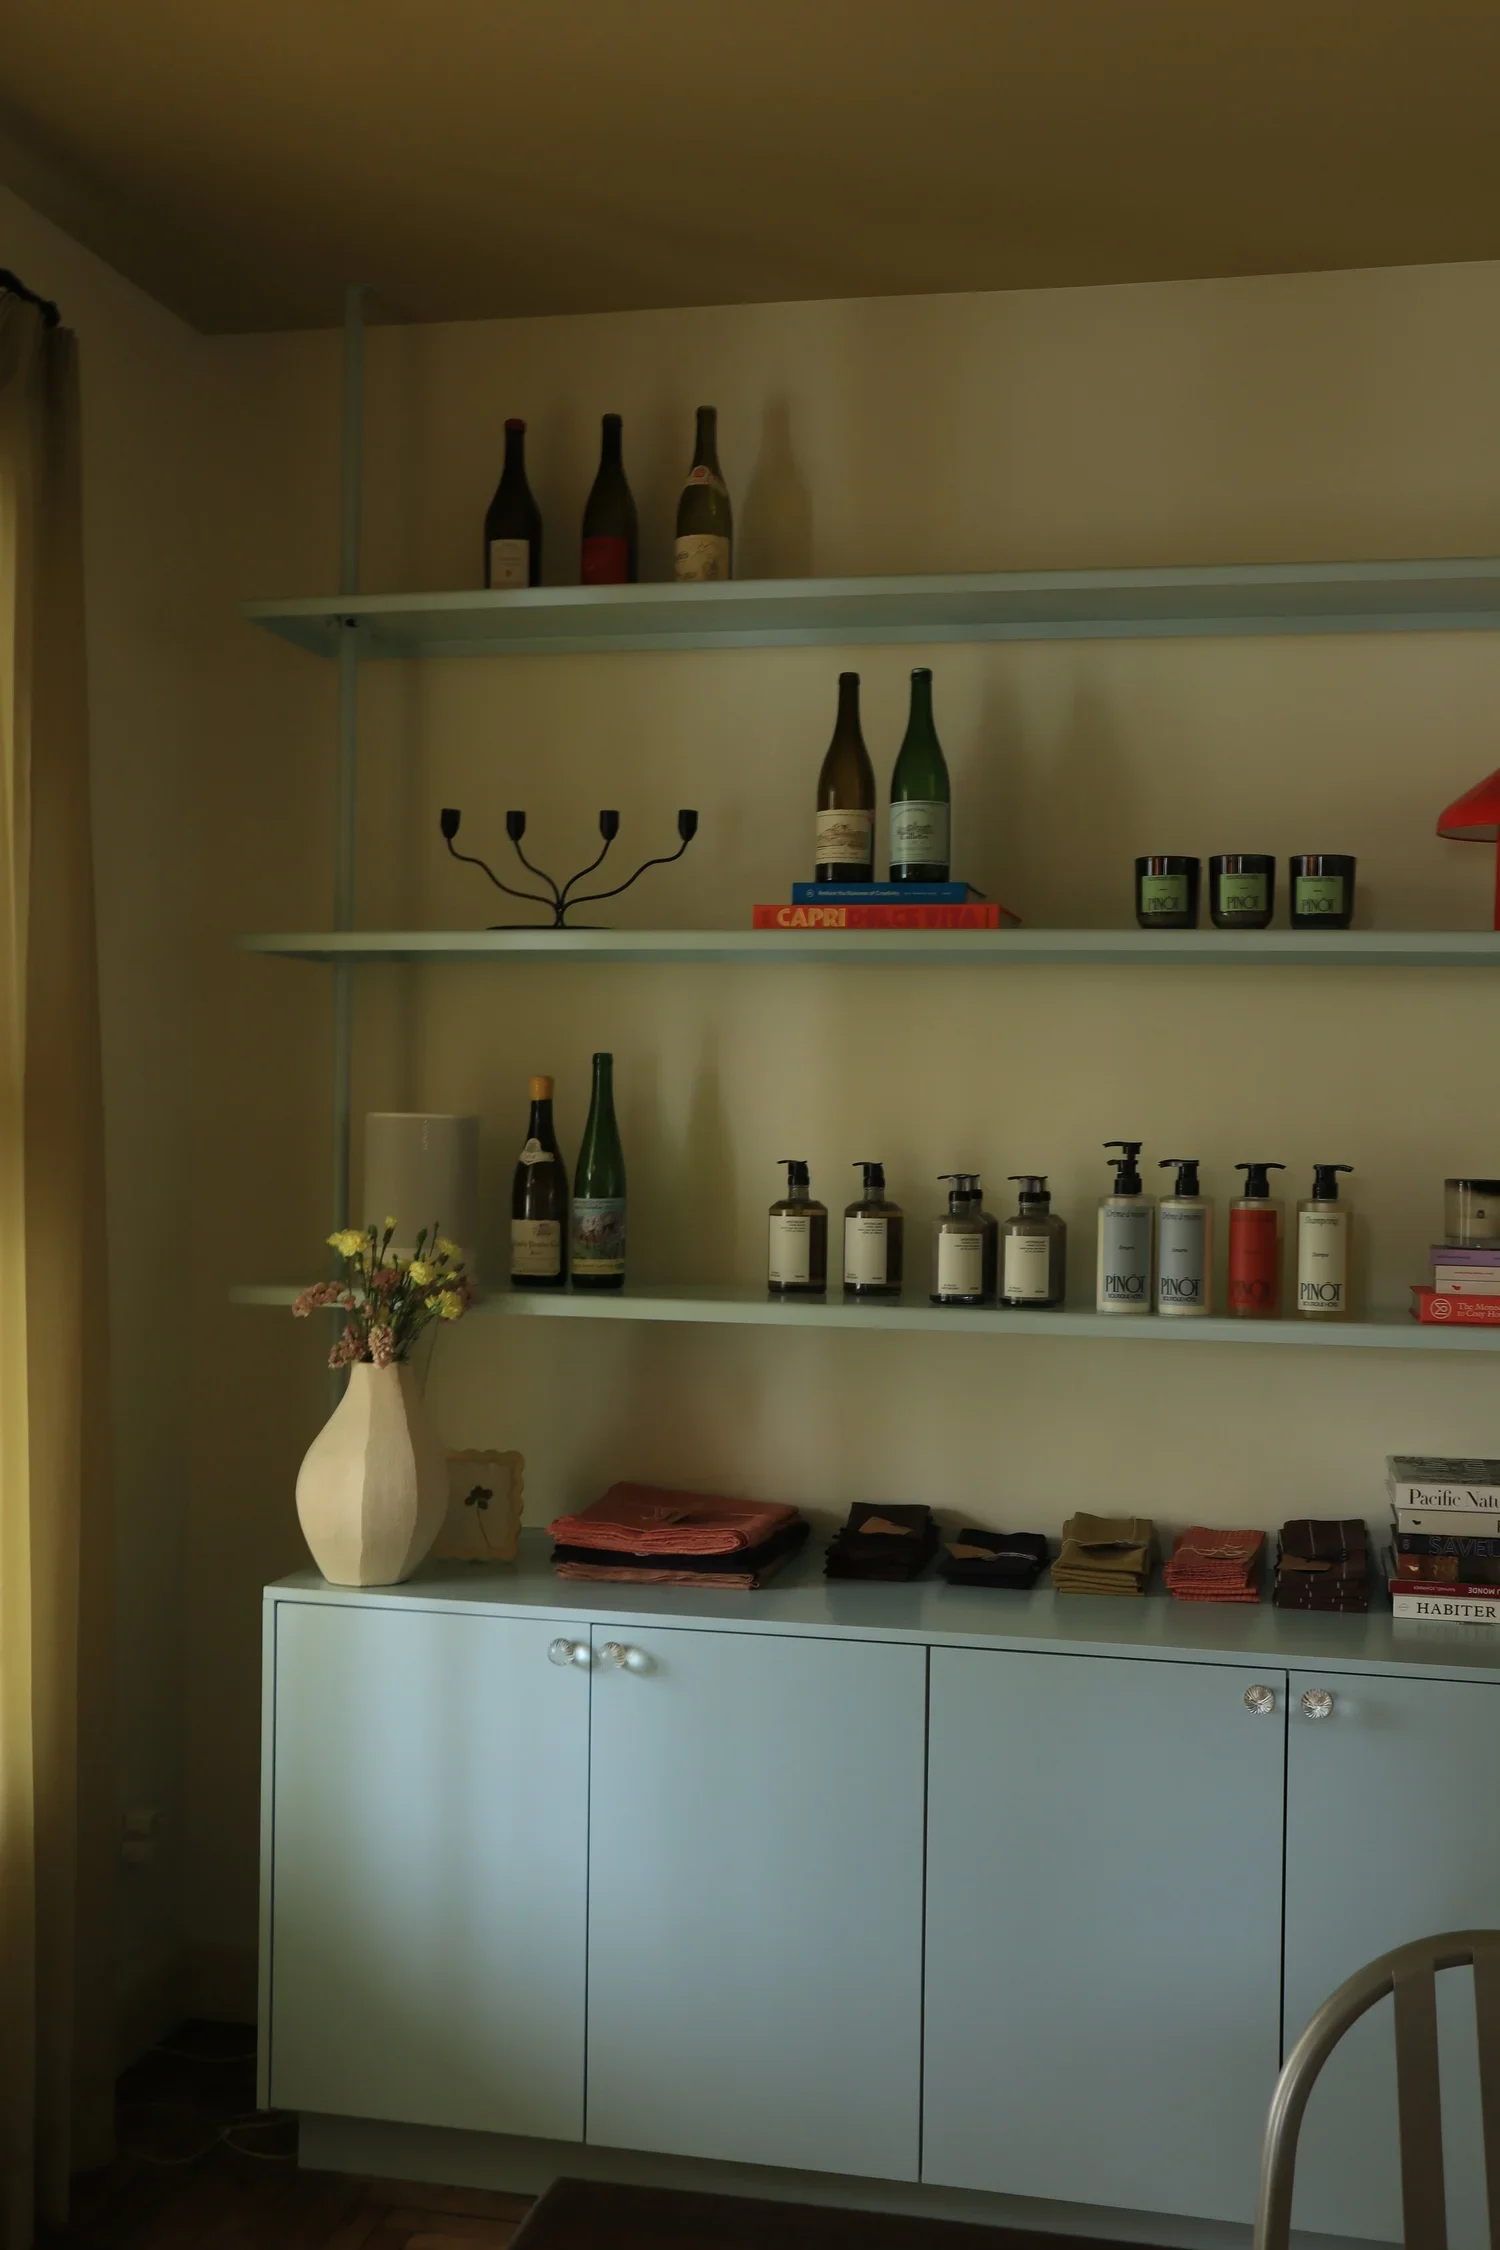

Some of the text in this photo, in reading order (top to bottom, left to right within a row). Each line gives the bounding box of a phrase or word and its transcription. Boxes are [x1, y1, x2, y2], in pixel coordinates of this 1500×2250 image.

[777, 907, 846, 928] CAPRI
[1476, 1304, 1500, 1312] Mono
[1409, 1488, 1460, 1507] Pacific
[1468, 1586, 1496, 1595] MONDE
[1417, 1602, 1496, 1618] HABITER
